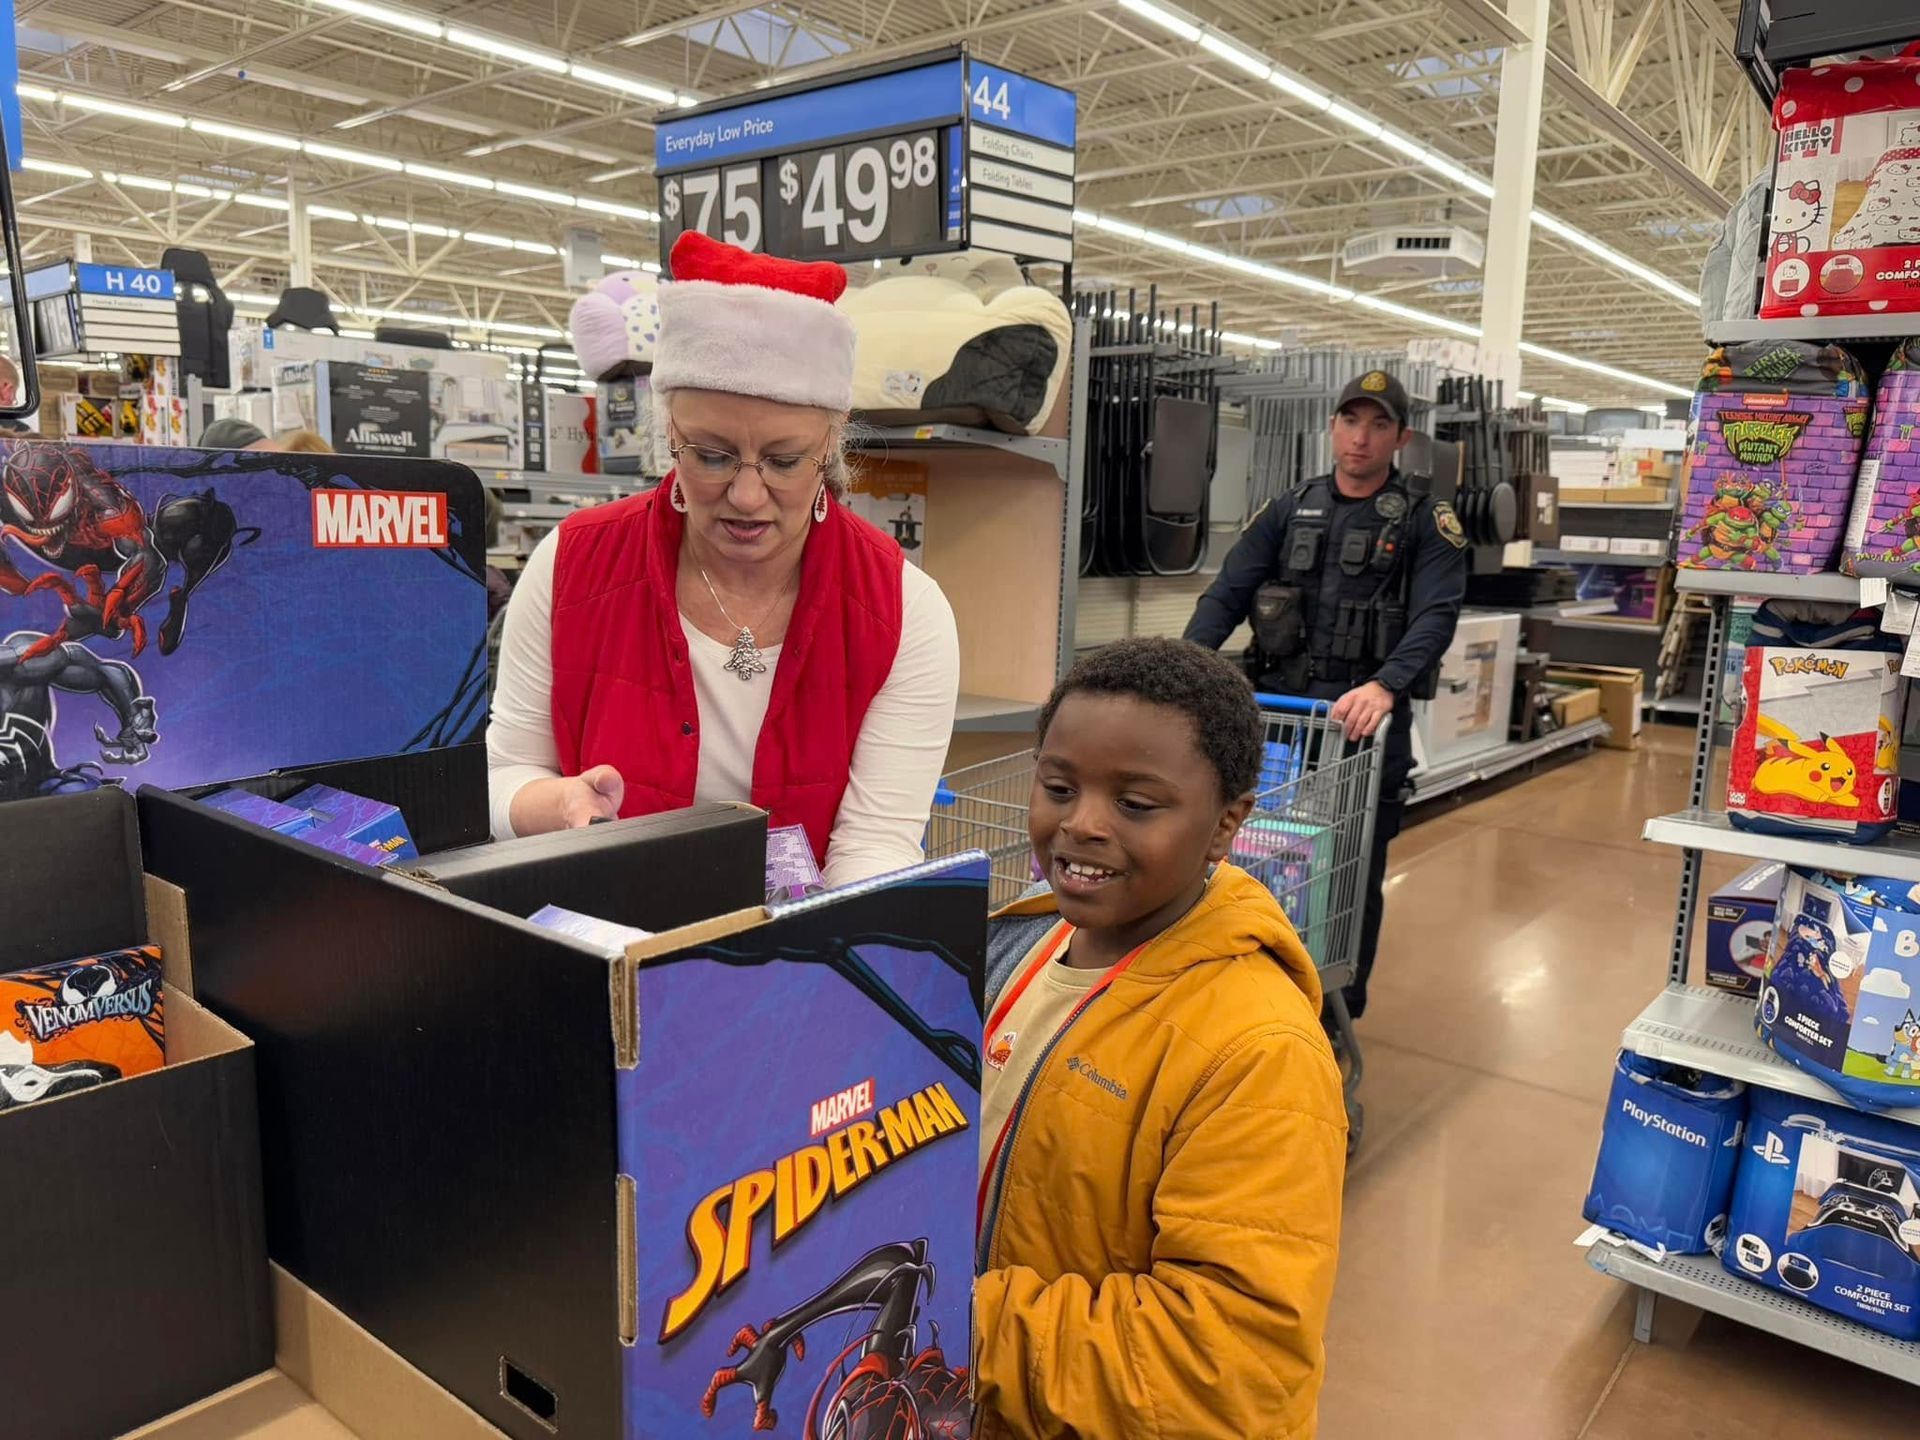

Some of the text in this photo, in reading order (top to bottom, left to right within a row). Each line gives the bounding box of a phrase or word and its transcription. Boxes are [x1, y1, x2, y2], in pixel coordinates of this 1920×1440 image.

[973, 75, 1010, 120] 44
[666, 118, 774, 152] Everyday Low Price
[1784, 137, 1833, 153] KITTY
[1785, 126, 1832, 142] HELLO
[982, 135, 1034, 160] Folding Chairs
[982, 167, 1034, 190] Folding Tables
[1904, 260, 1911, 269] 2
[105, 271, 161, 294] H 40
[1740, 441, 1779, 454] MUTANT
[1740, 452, 1774, 463] MAYHEM
[316, 493, 444, 545] MARVEL
[1784, 1015, 1819, 1041] COMFORTER
[1819, 1035, 1834, 1047] SET
[1801, 1015, 1820, 1031] PIECE
[1079, 1063, 1128, 1100] Columbia
[811, 1079, 873, 1136] MARVEL
[1622, 1098, 1707, 1147] PlayStation
[660, 1081, 968, 1342] SPIDER-MAN
[1834, 1285, 1912, 1313] COMFORTER SET
[1856, 1284, 1892, 1301] 2 PIECE
